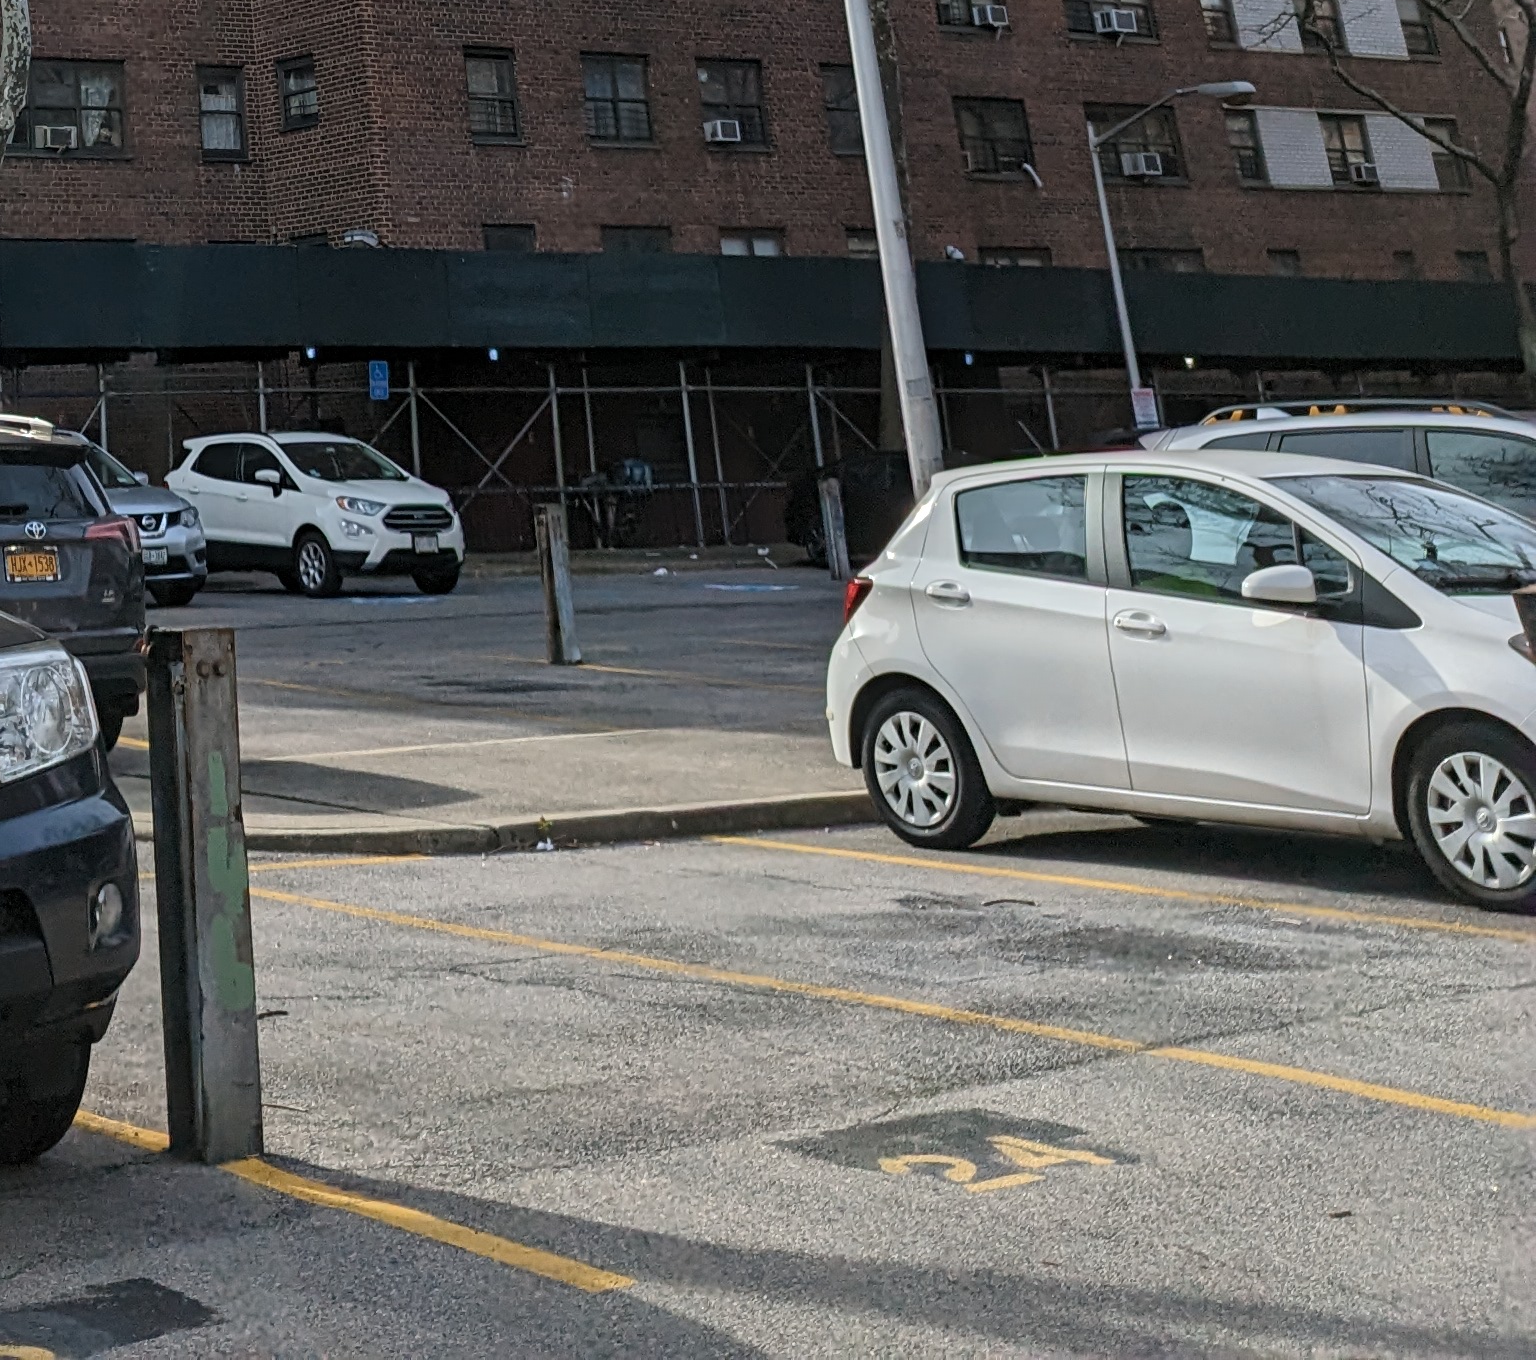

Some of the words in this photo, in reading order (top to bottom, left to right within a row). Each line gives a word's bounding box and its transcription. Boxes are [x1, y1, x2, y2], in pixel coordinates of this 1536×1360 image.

[10, 554, 28, 573] HJX
[33, 554, 56, 573] 1538
[877, 1133, 1118, 1194] 24
